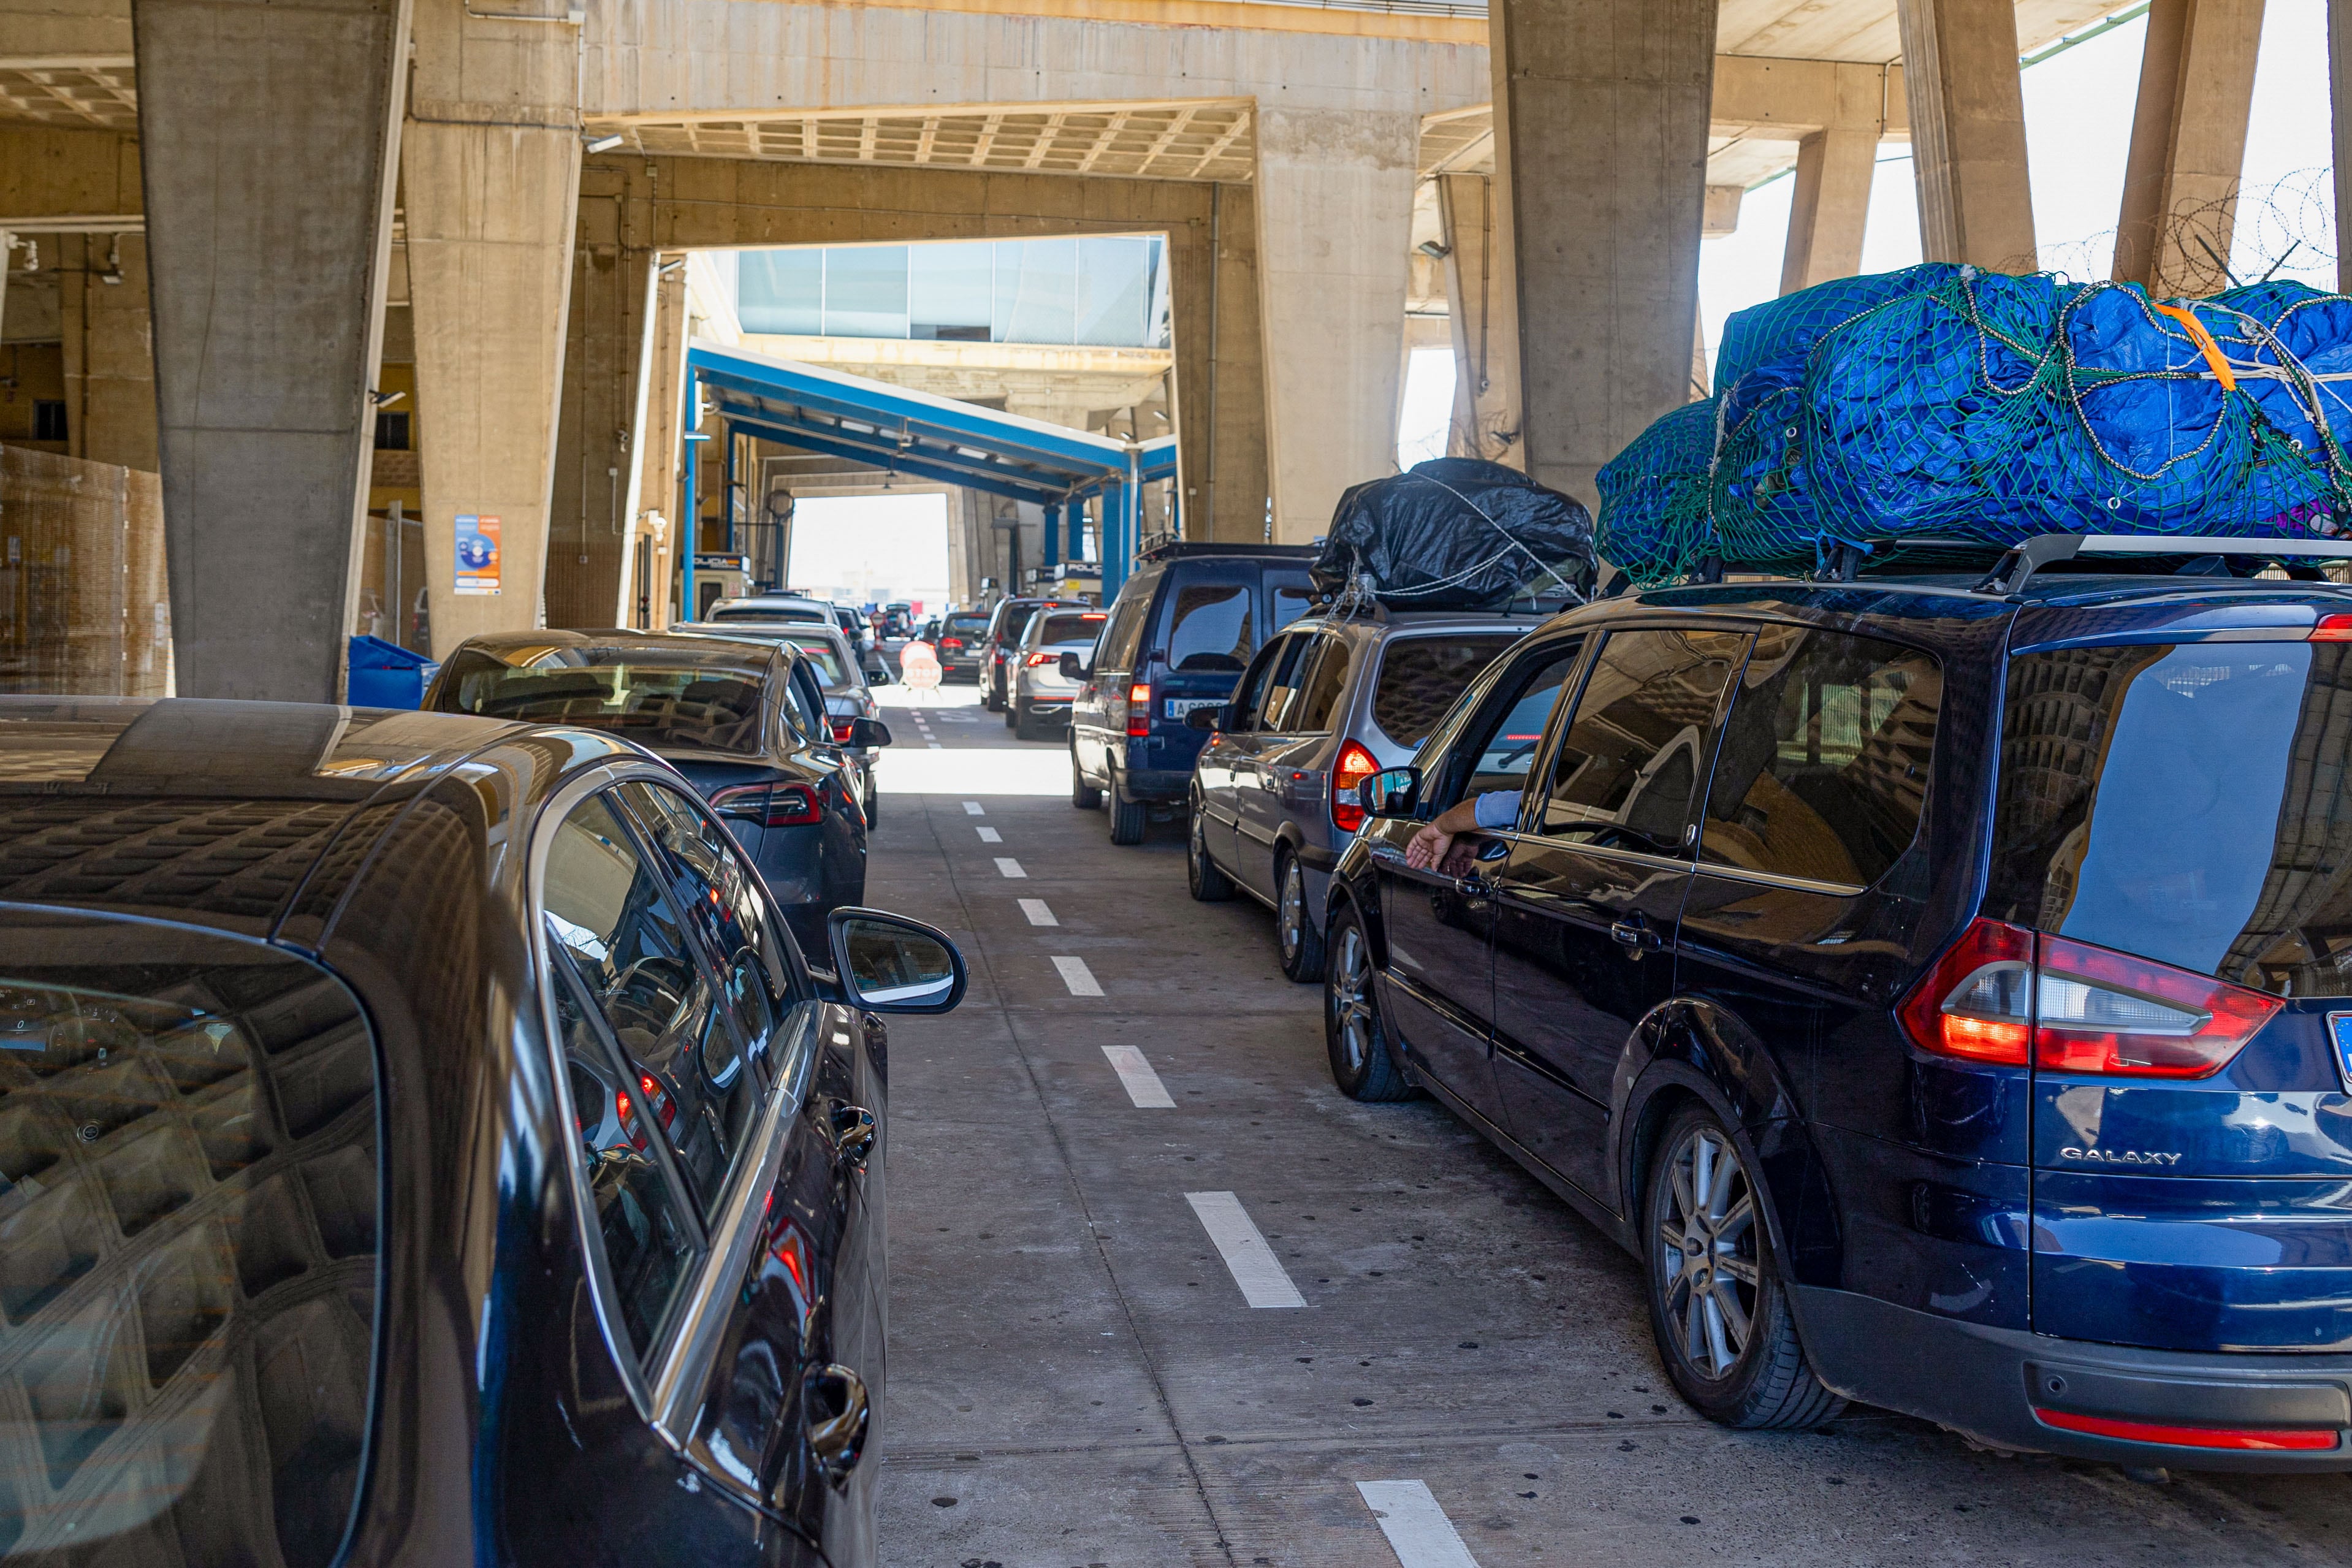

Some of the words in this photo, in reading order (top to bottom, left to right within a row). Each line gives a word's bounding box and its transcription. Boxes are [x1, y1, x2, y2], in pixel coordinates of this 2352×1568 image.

[1068, 563, 1102, 572] POLIC
[907, 668, 938, 677] STOP
[2059, 1147, 2183, 1166] GALAXY
